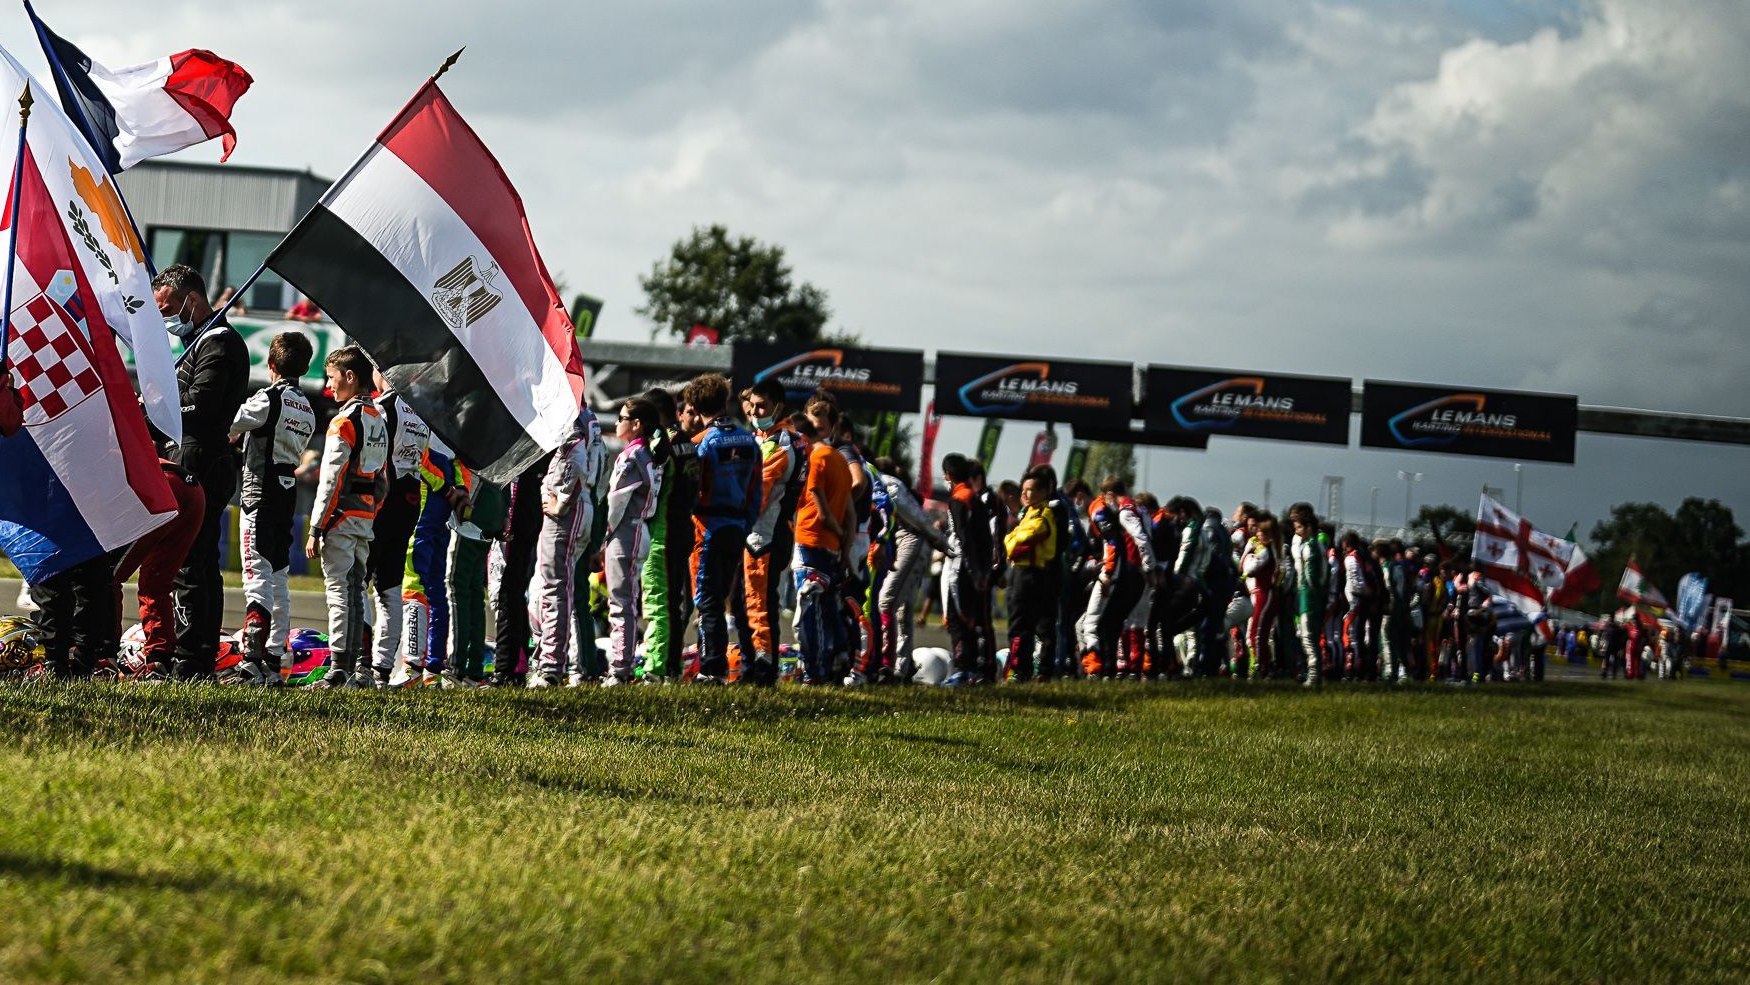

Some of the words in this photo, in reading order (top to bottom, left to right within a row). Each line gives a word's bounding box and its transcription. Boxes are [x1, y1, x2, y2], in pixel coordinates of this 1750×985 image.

[794, 364, 815, 377] LE
[815, 365, 872, 381] MANS
[999, 376, 1020, 390] LE
[1020, 378, 1079, 394] MANS
[1211, 392, 1234, 405] LE
[1234, 394, 1294, 410] MANS
[284, 417, 301, 428] KART
[1431, 408, 1454, 422] LE
[1454, 410, 1517, 427] MANS
